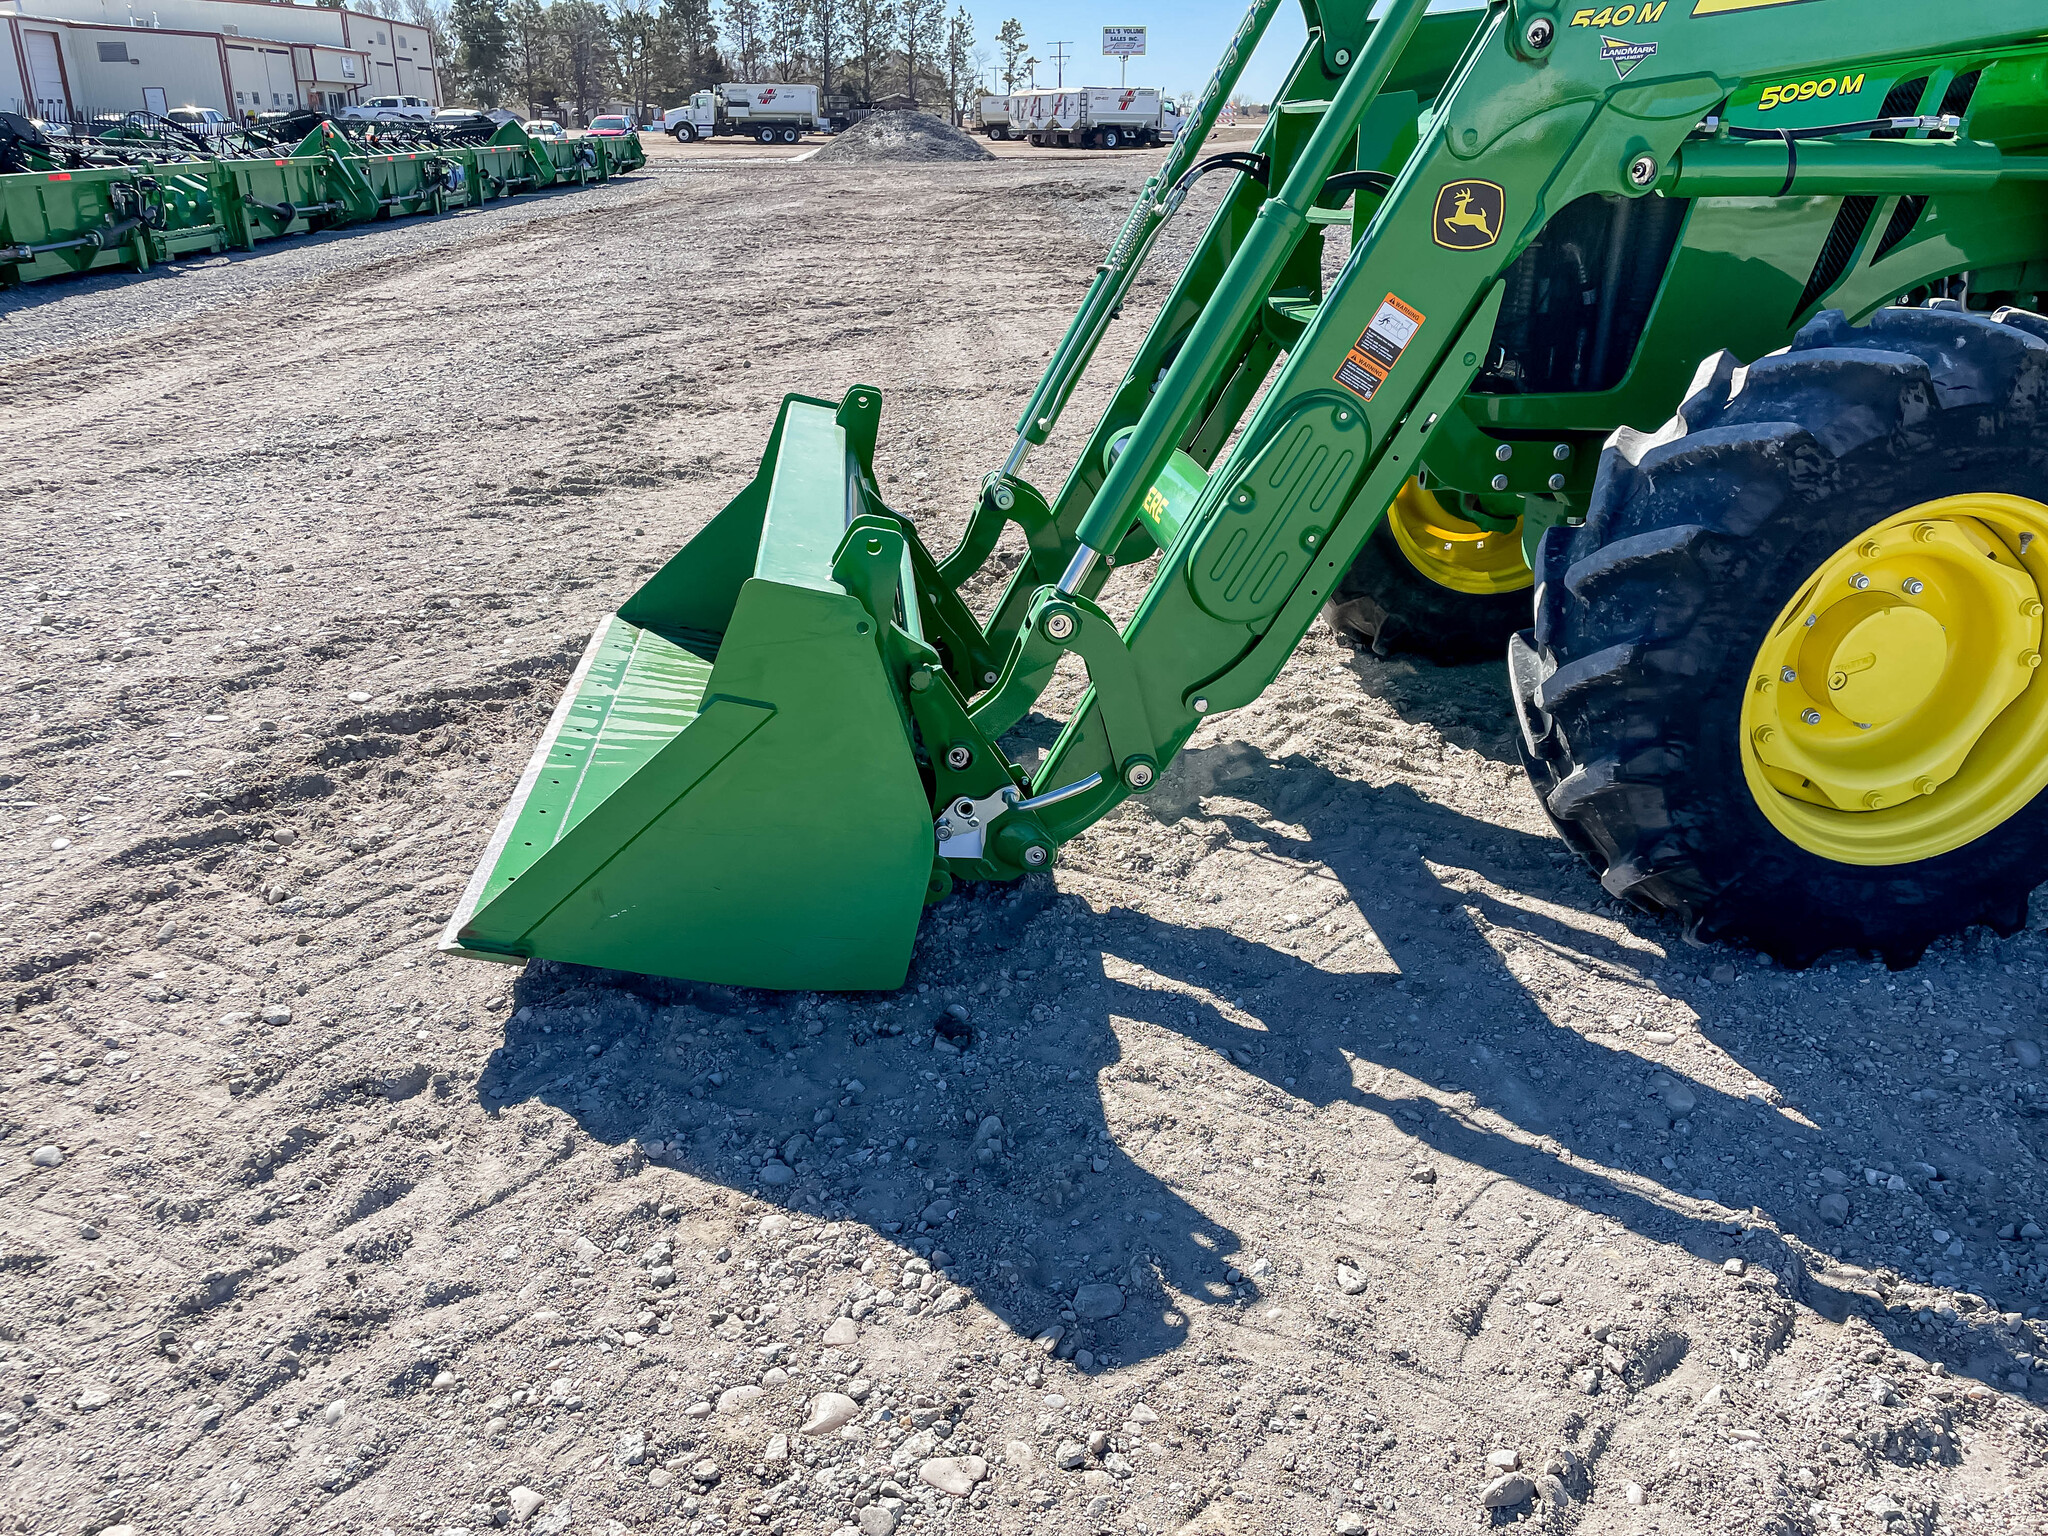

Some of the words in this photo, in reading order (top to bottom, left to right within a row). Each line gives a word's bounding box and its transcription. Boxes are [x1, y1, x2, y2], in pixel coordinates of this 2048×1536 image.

[1569, 4, 1636, 28] 540
[1634, 0, 1669, 25] M
[1757, 79, 1836, 110] 5090
[1838, 73, 1865, 96] M
[1395, 301, 1420, 321] WARNING
[1358, 358, 1383, 377] WARNING
[1142, 486, 1169, 524] ERE
